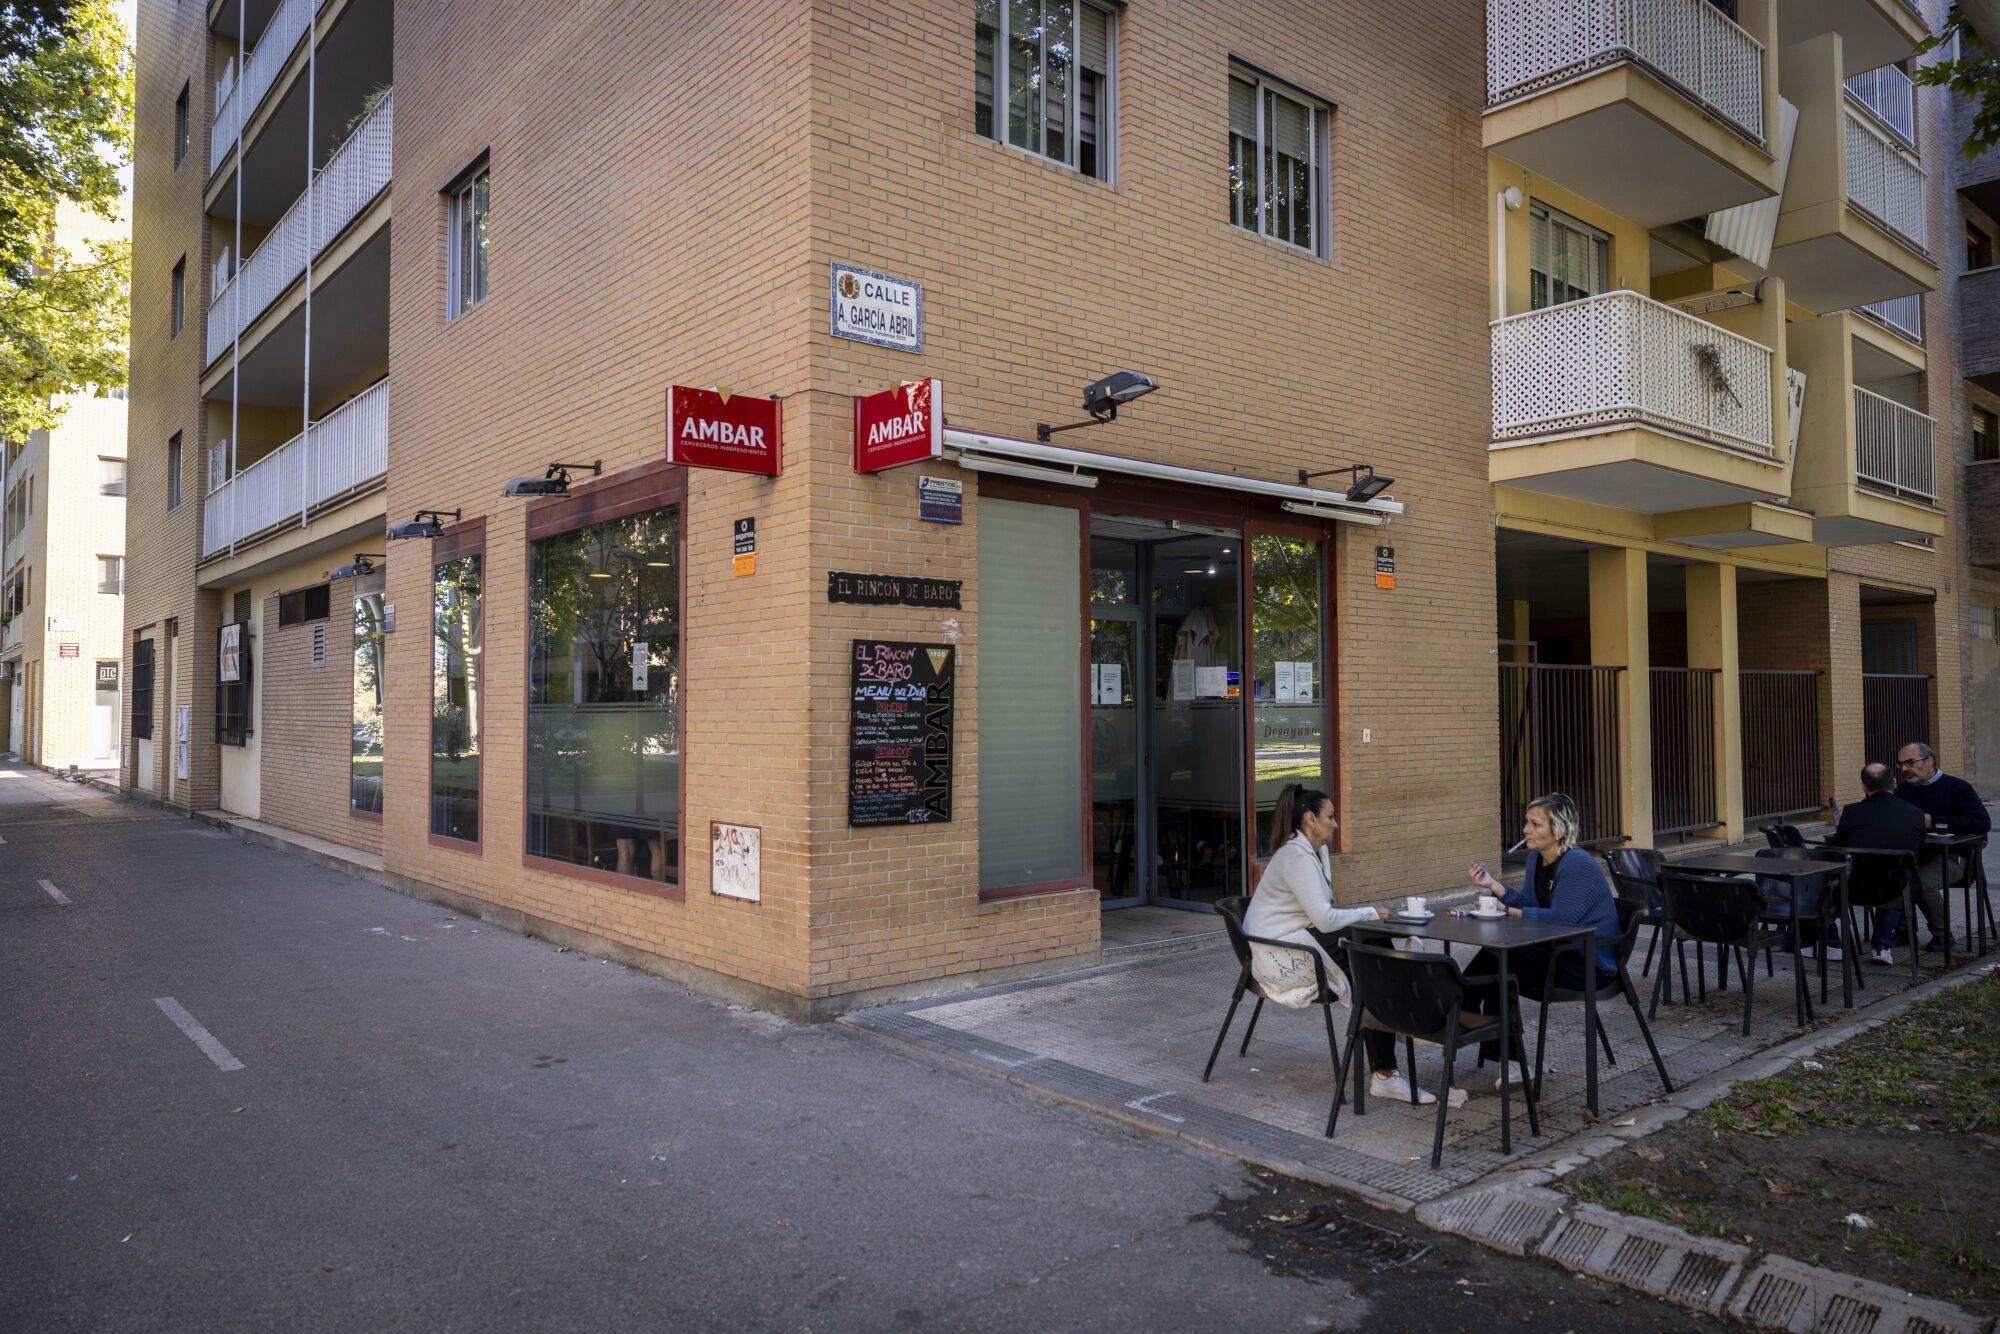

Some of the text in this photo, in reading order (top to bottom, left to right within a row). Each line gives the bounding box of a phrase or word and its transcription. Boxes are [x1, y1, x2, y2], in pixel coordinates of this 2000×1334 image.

[864, 282, 910, 306] CALLE
[838, 302, 915, 338] A. GARCÍA ABRIL
[681, 417, 767, 448] AMBAR
[868, 411, 925, 446] AMBAR
[680, 440, 767, 456] CERVECEROS INDEPENDIENTES
[868, 434, 926, 453] CERVECEROS INDEPENDIENTES
[838, 579, 851, 595] EL
[906, 583, 918, 598] DE
[924, 585, 953, 600] BARO
[856, 645, 872, 660] EL
[859, 660, 912, 680] DE BARO
[925, 676, 950, 819] AMBAR
